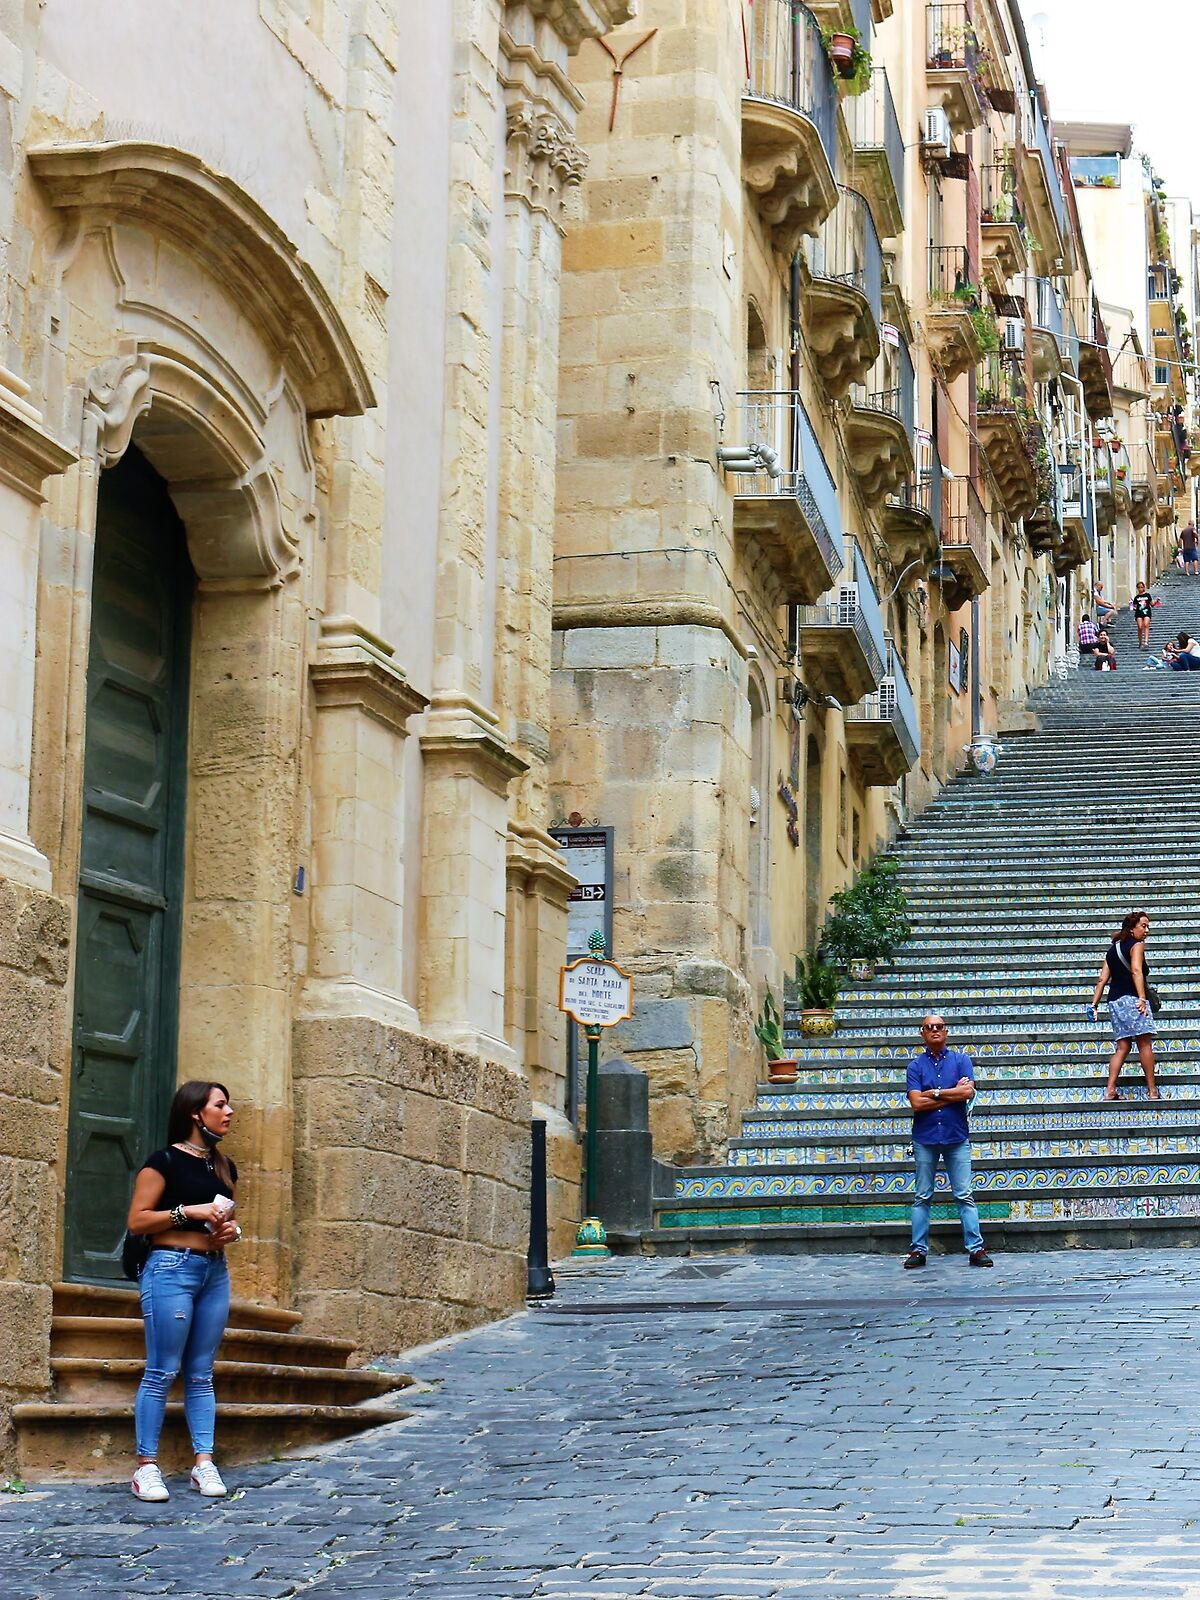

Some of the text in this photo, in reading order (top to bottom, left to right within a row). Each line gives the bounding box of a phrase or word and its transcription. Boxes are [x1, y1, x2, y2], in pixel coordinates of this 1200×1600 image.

[586, 965, 607, 976] SCALA
[578, 976, 598, 986] SANTA
[603, 979, 622, 989] MARIA
